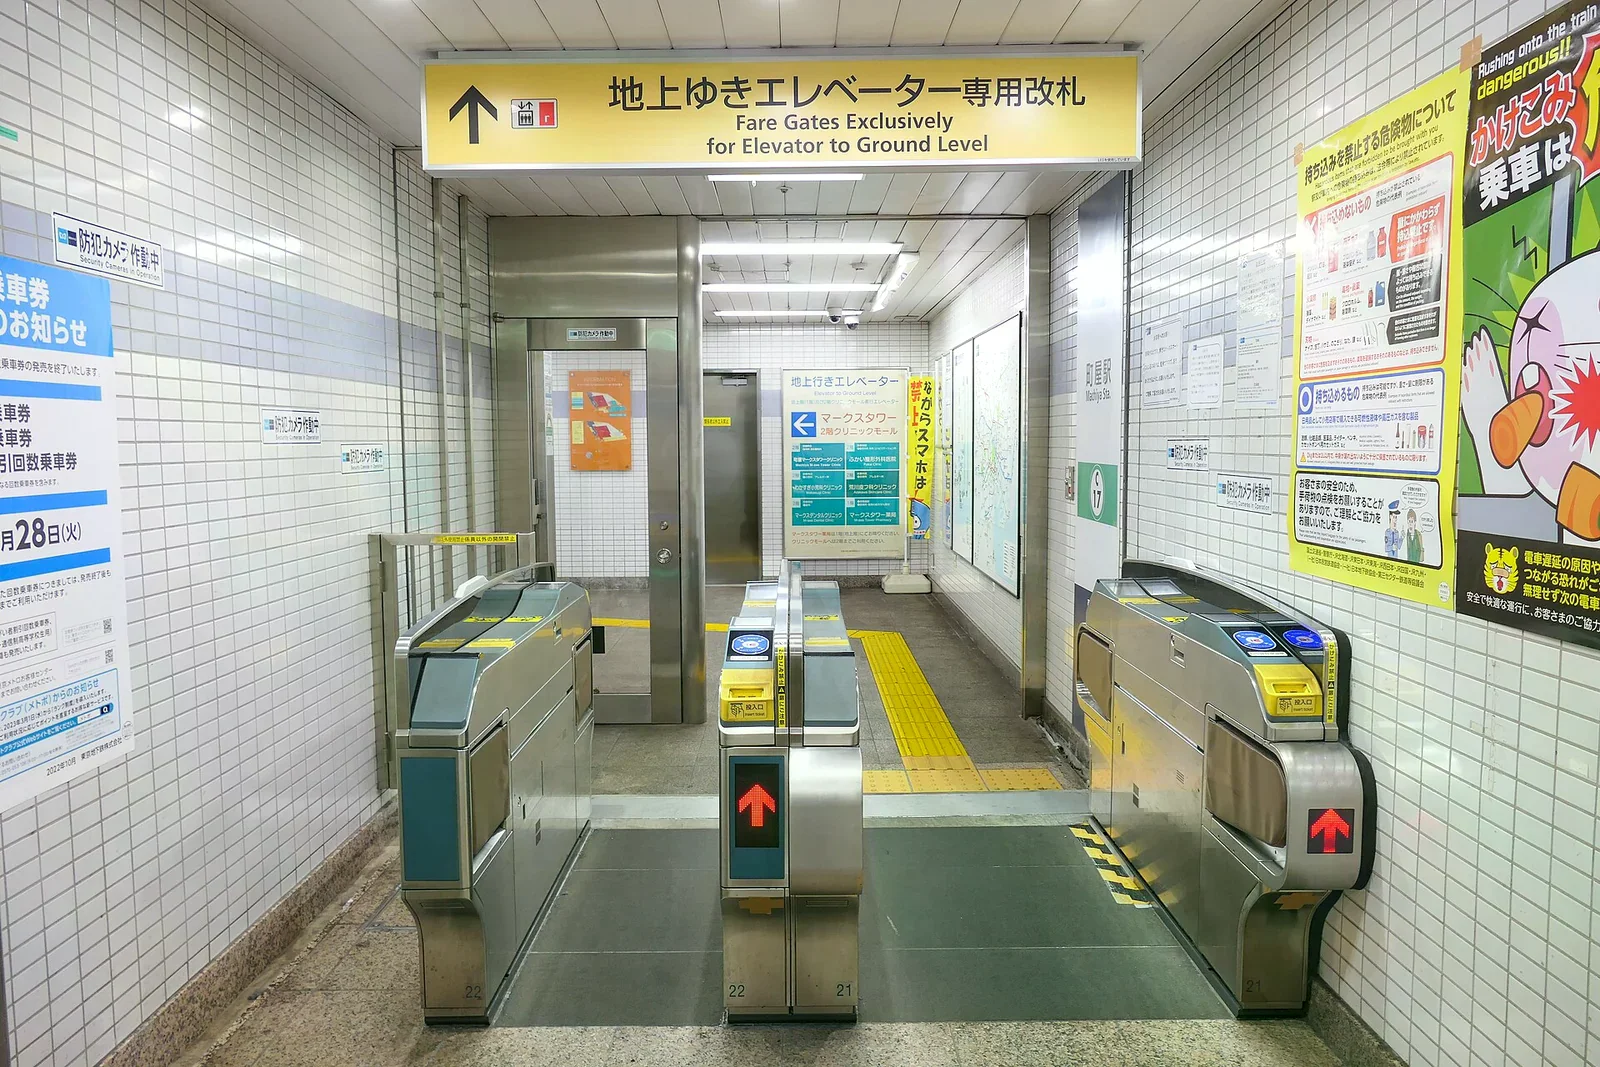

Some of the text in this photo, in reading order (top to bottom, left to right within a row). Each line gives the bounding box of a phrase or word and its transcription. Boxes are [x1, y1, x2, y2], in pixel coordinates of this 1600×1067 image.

[1478, 4, 1598, 80] Rushing onto the train
[1477, 35, 1572, 100] dangerous!!
[608, 73, 1086, 111] 地上ゆきエレベーター専用改札
[736, 111, 954, 133] Fare Gates Exclusively
[1470, 70, 1576, 167] かけこみ
[707, 134, 988, 155] for Elevator to Ground Level
[1304, 89, 1457, 187] 持ち込みを禁止する危険物について
[1479, 132, 1572, 211] 乗車は
[78, 227, 160, 272] 防犯カメラ作動中
[79, 254, 104, 269] Security
[105, 261, 129, 275] Cameras
[0, 357, 100, 378] 乗車券の発売を終了いたします。
[1086, 357, 1112, 387] 町屋駅
[791, 376, 899, 388] 地上行きエレベーター
[1315, 386, 1360, 405] 持ち込めるもの
[0, 403, 31, 424] 車券
[820, 412, 897, 424] マークスタワー
[820, 427, 898, 436] 2階クリニックモール
[915, 380, 932, 490] ながらスマホは
[1299, 478, 1358, 493] お客さまの安全のため、
[1092, 489, 1101, 509] 17
[1299, 490, 1385, 510] 手荷物の点検をお願いすることが
[1299, 503, 1382, 524] ありますので、ご理解とご協力を
[1299, 516, 1344, 532] お願いいたします。
[1523, 568, 1600, 592] つながる恐れがご
[464, 985, 482, 999] 22
[728, 984, 746, 998] 22
[836, 983, 853, 997] 21
[1246, 979, 1261, 993] 21
